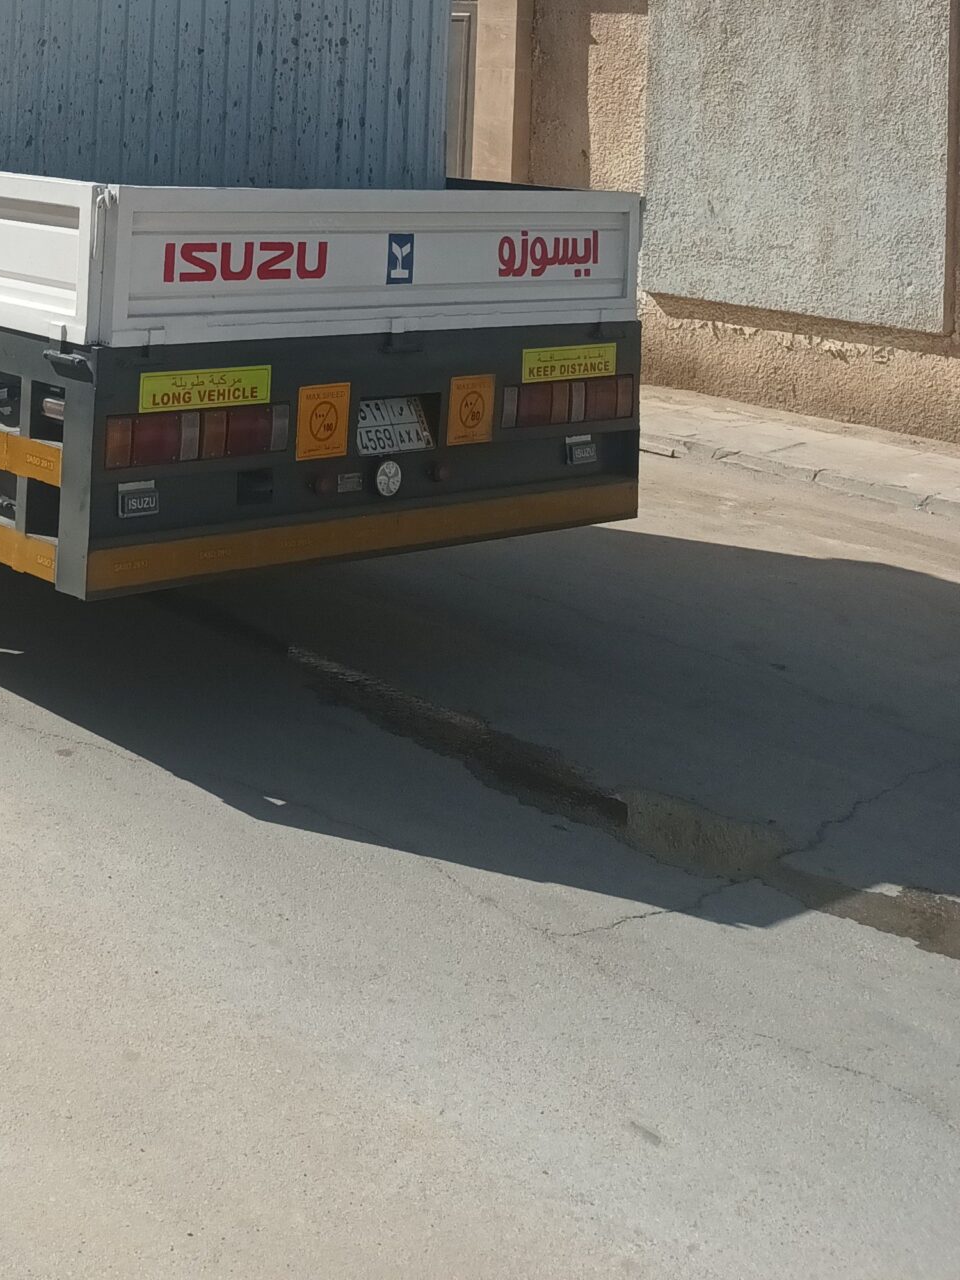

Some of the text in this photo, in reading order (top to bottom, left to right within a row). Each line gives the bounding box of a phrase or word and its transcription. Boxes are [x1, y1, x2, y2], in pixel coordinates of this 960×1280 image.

[162, 241, 329, 284] ISUZU
[497, 230, 600, 279] ايسوزو
[528, 361, 610, 378] KEEP DISTANCE
[171, 374, 242, 390] مركبة طويلة
[152, 386, 258, 406] LONG VEHICLE
[359, 428, 394, 451] 4569
[575, 448, 595, 458] ISUZU
[26, 454, 54, 470] SASO 2913
[128, 496, 156, 510] ISUZU
